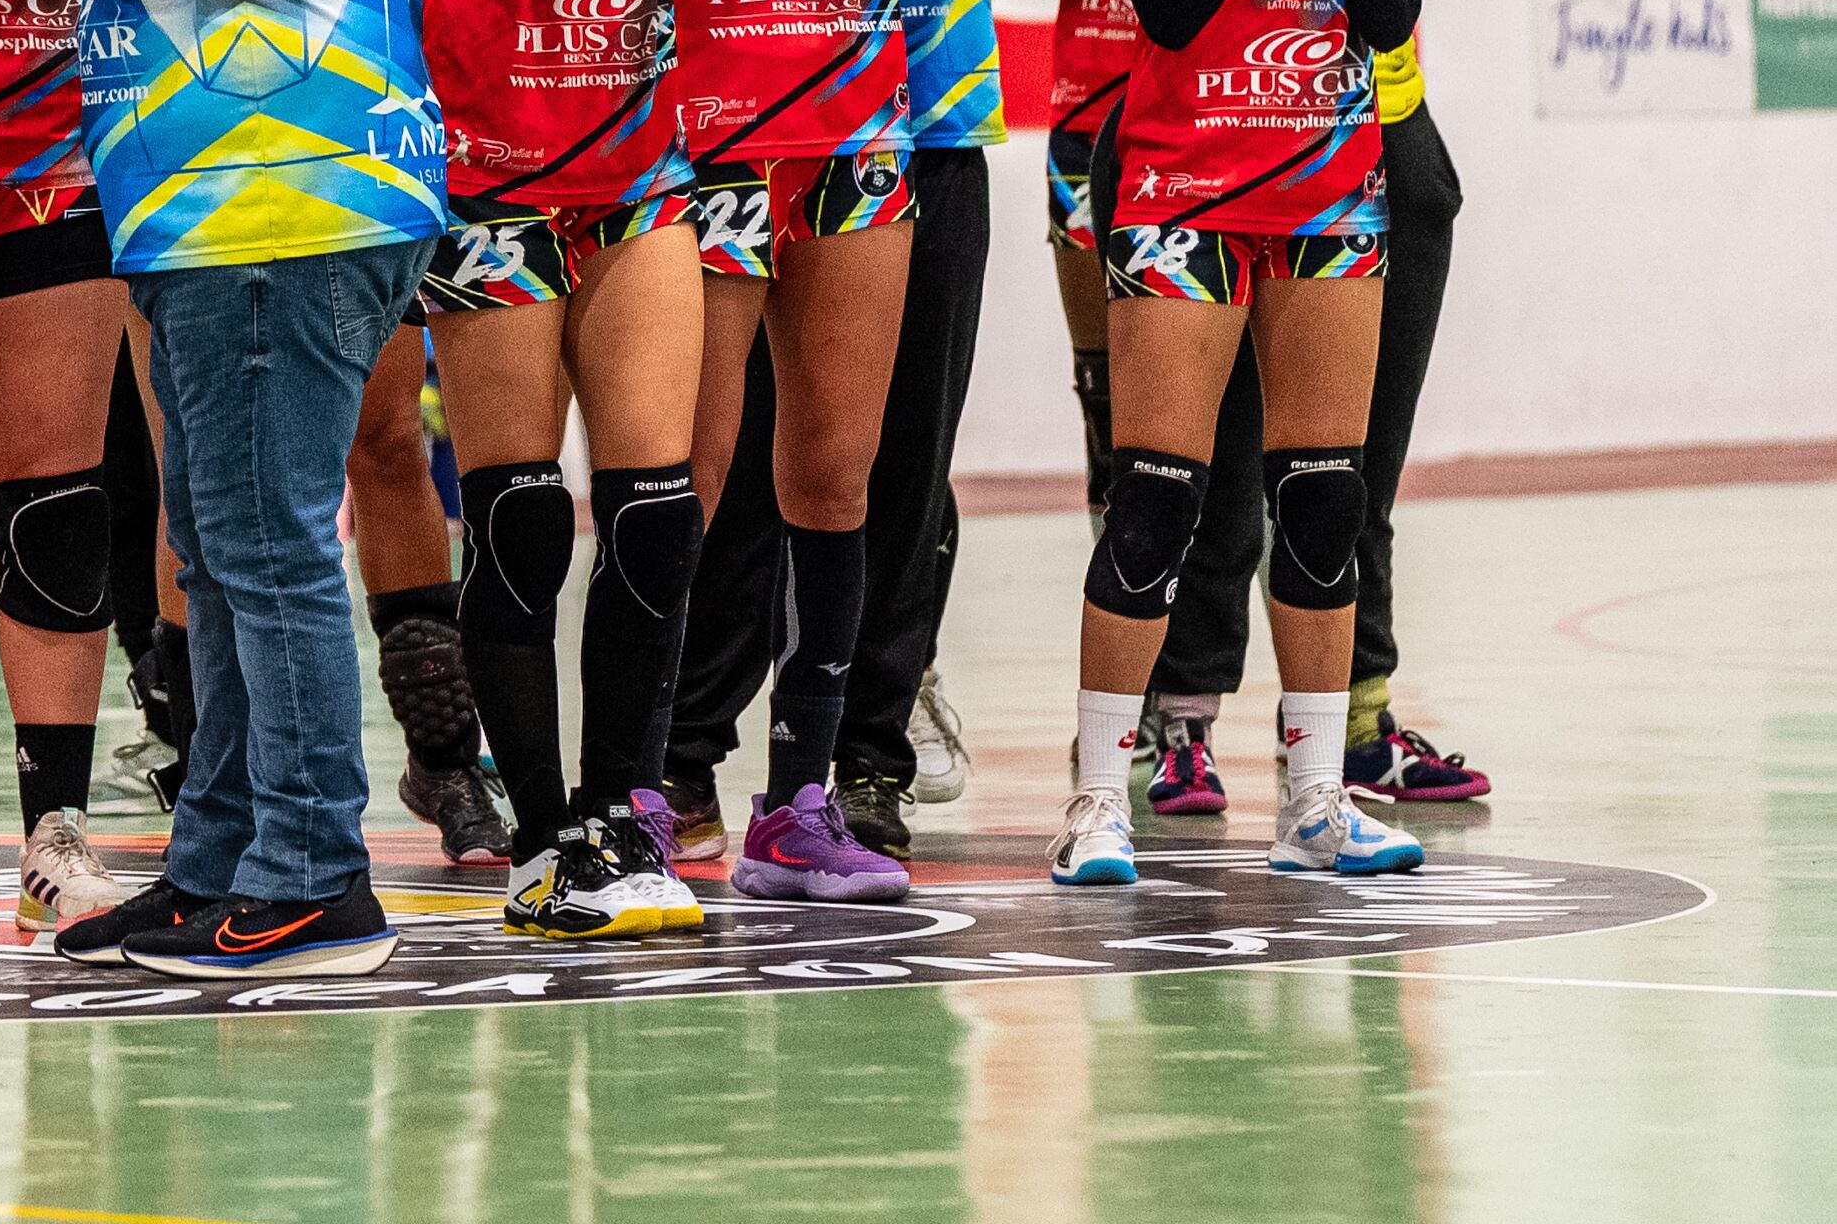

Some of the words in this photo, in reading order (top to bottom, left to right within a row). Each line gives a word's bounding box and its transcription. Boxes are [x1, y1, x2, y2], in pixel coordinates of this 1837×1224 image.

[33, 15, 73, 27] CAR
[771, 2, 820, 12] RENT
[514, 24, 608, 53] PLUS
[563, 53, 602, 64] RENT
[1197, 71, 1301, 98] PLUS
[1249, 96, 1295, 106] RENT
[699, 190, 771, 252] 22
[453, 222, 534, 285] 25
[1126, 225, 1200, 275] 28
[1099, 927, 1409, 957] DE
